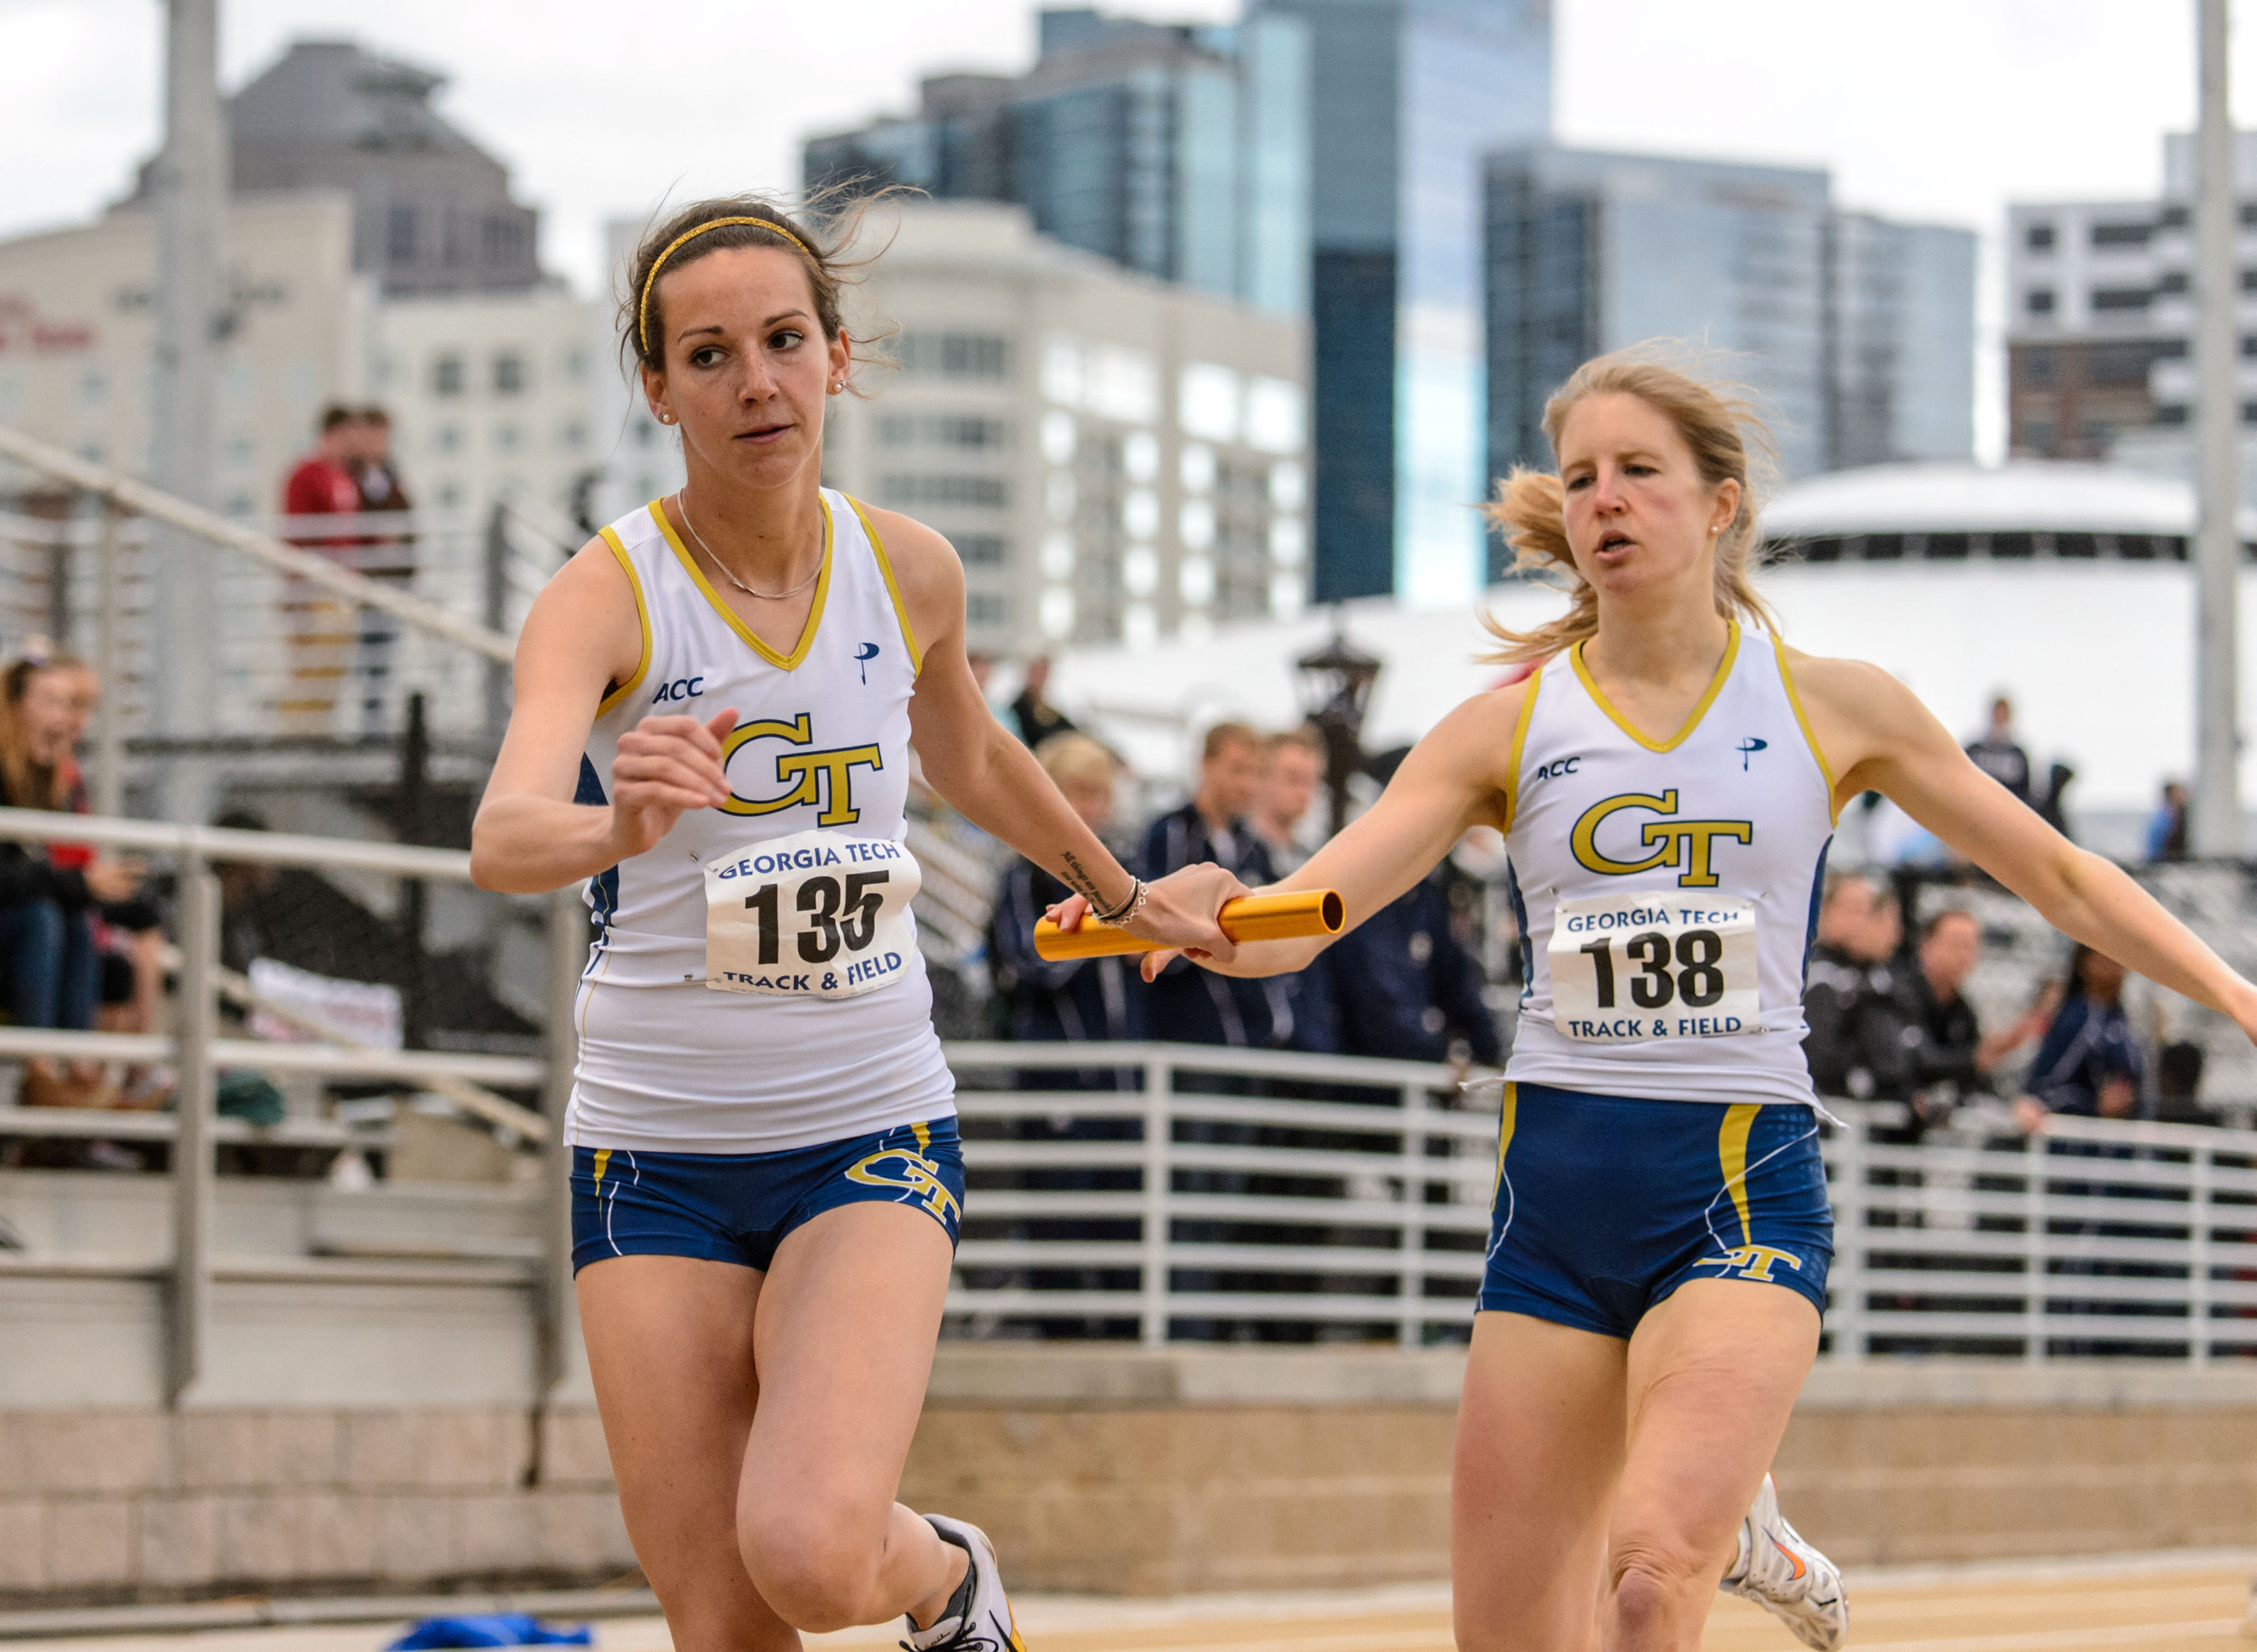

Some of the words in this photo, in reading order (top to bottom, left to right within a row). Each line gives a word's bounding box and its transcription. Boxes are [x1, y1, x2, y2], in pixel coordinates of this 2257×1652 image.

[652, 677, 703, 704] ACC
[710, 711, 884, 829] GT
[1537, 756, 1580, 780] ACC
[1569, 788, 1753, 887] GT
[718, 847, 841, 880] GEORGIA
[845, 842, 901, 863] TECH
[745, 869, 890, 965] 135
[1567, 907, 1670, 933] GEORGIA
[1679, 909, 1739, 925] TECH
[722, 971, 810, 991] TRACK
[821, 971, 839, 991] &
[846, 951, 902, 987] FIELD
[1580, 929, 1724, 1009] 138
[1568, 1019, 1643, 1037] TRACK
[1652, 1019, 1667, 1037] &
[1678, 1016, 1742, 1036] FIELD
[844, 1148, 961, 1226] GT
